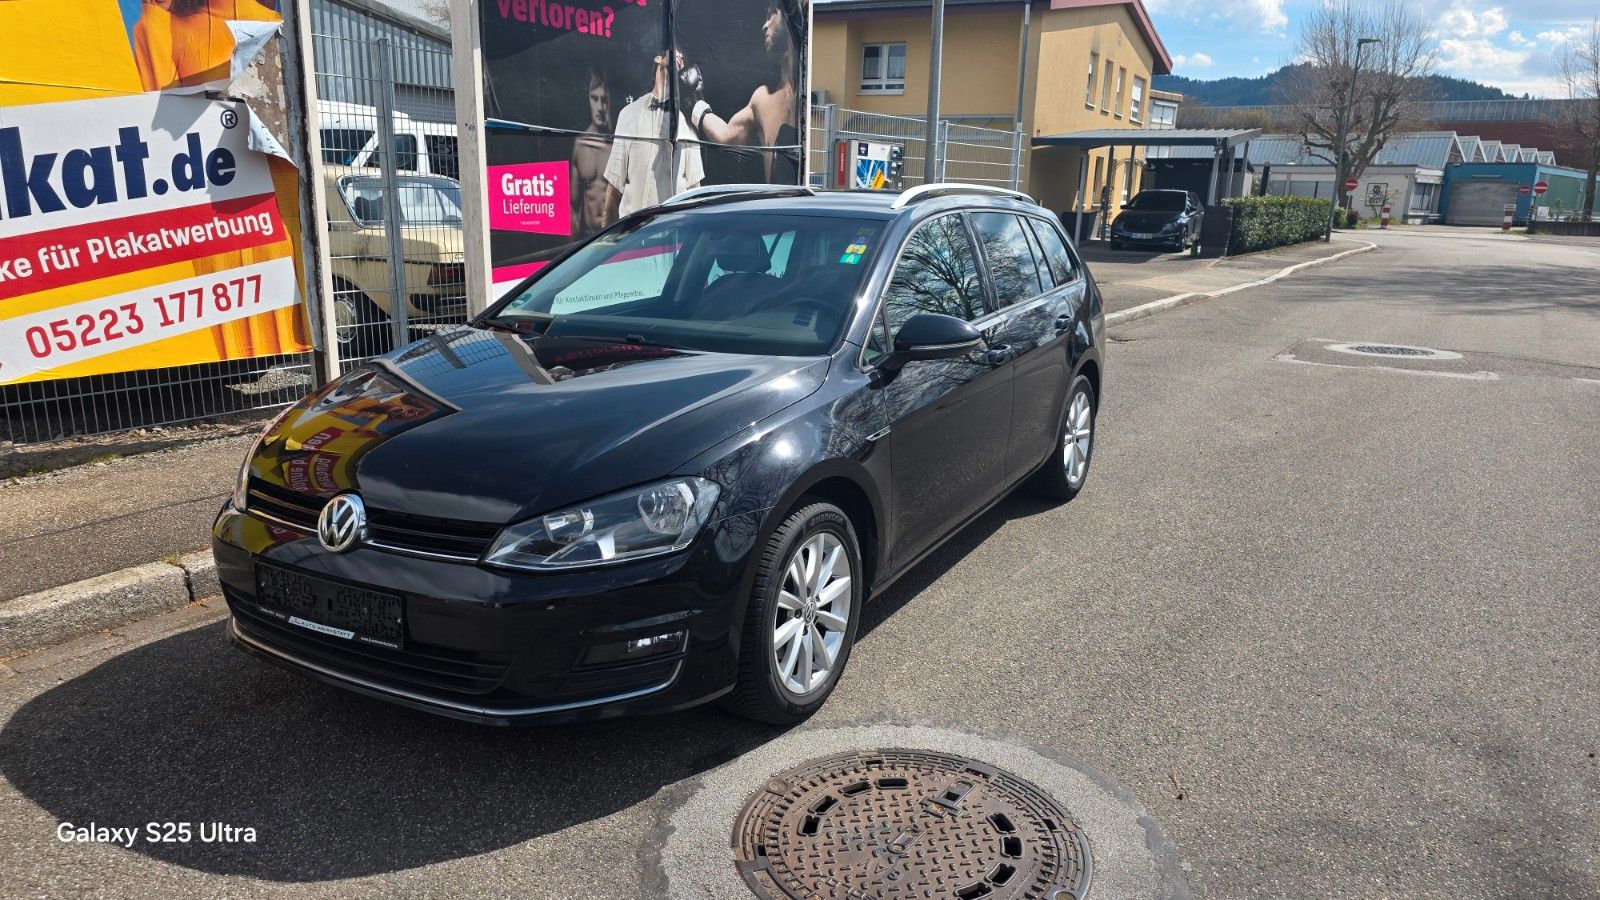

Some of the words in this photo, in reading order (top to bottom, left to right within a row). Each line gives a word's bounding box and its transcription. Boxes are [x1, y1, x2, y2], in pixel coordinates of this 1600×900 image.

[496, 0, 615, 38] verloren?
[0, 126, 236, 221] kat.de
[502, 198, 555, 218] Lieferung
[38, 244, 82, 274] für
[86, 211, 274, 264] Plakatwerbung
[25, 302, 145, 359] 05223
[153, 287, 206, 329] 177
[211, 274, 263, 315] 877
